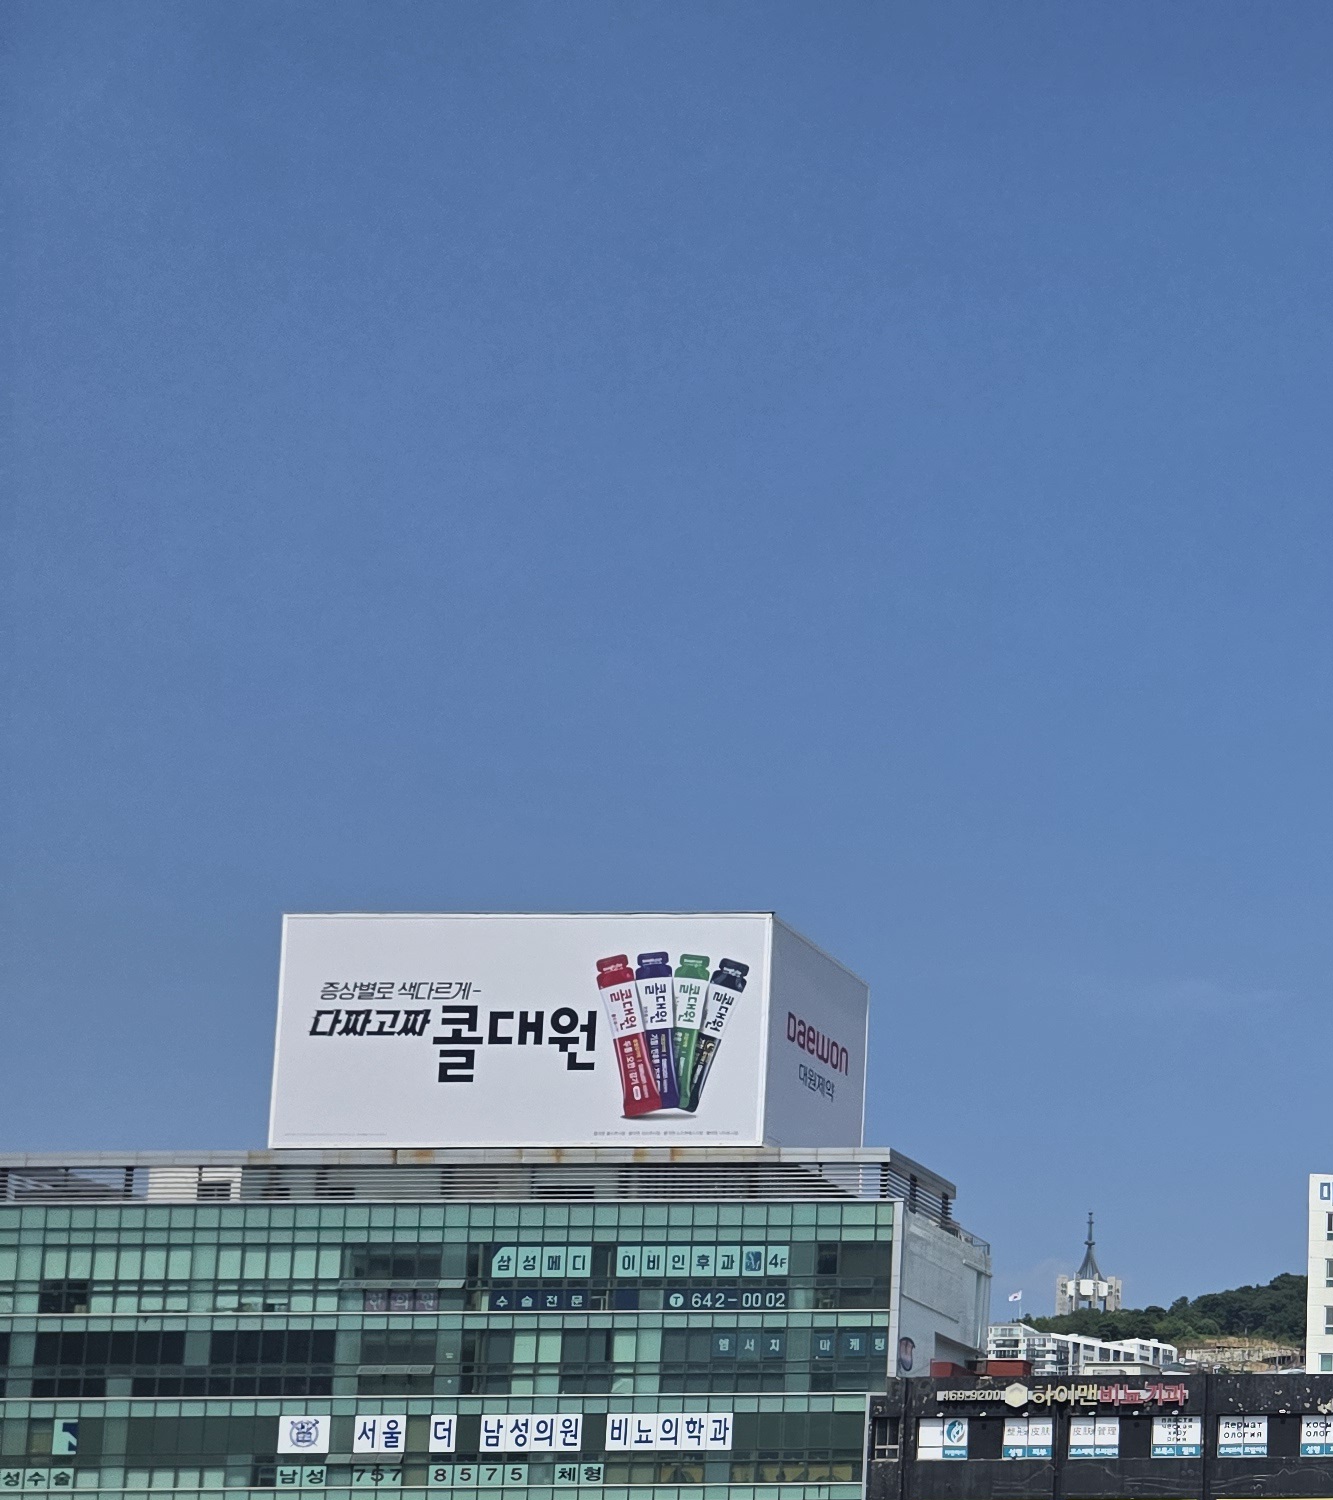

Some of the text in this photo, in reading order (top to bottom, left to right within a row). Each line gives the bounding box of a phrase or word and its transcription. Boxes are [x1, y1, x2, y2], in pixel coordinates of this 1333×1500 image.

[320, 982, 396, 1000] 증상별로
[610, 988, 637, 1030] 콜대원
[644, 982, 667, 1024] 콜대원
[677, 982, 701, 1024] 콜대원
[704, 990, 734, 1032] 콜대원
[308, 1008, 432, 1036] 다짜고짜
[432, 1004, 598, 1082] 콜대원
[786, 1011, 849, 1076] Daewon
[798, 1064, 835, 1102] 대원제약
[768, 1253, 786, 1268] 4F
[691, 1292, 785, 1307] 642-0002
[356, 1416, 732, 1450] 서울 더 남성의원 비뇨의학과
